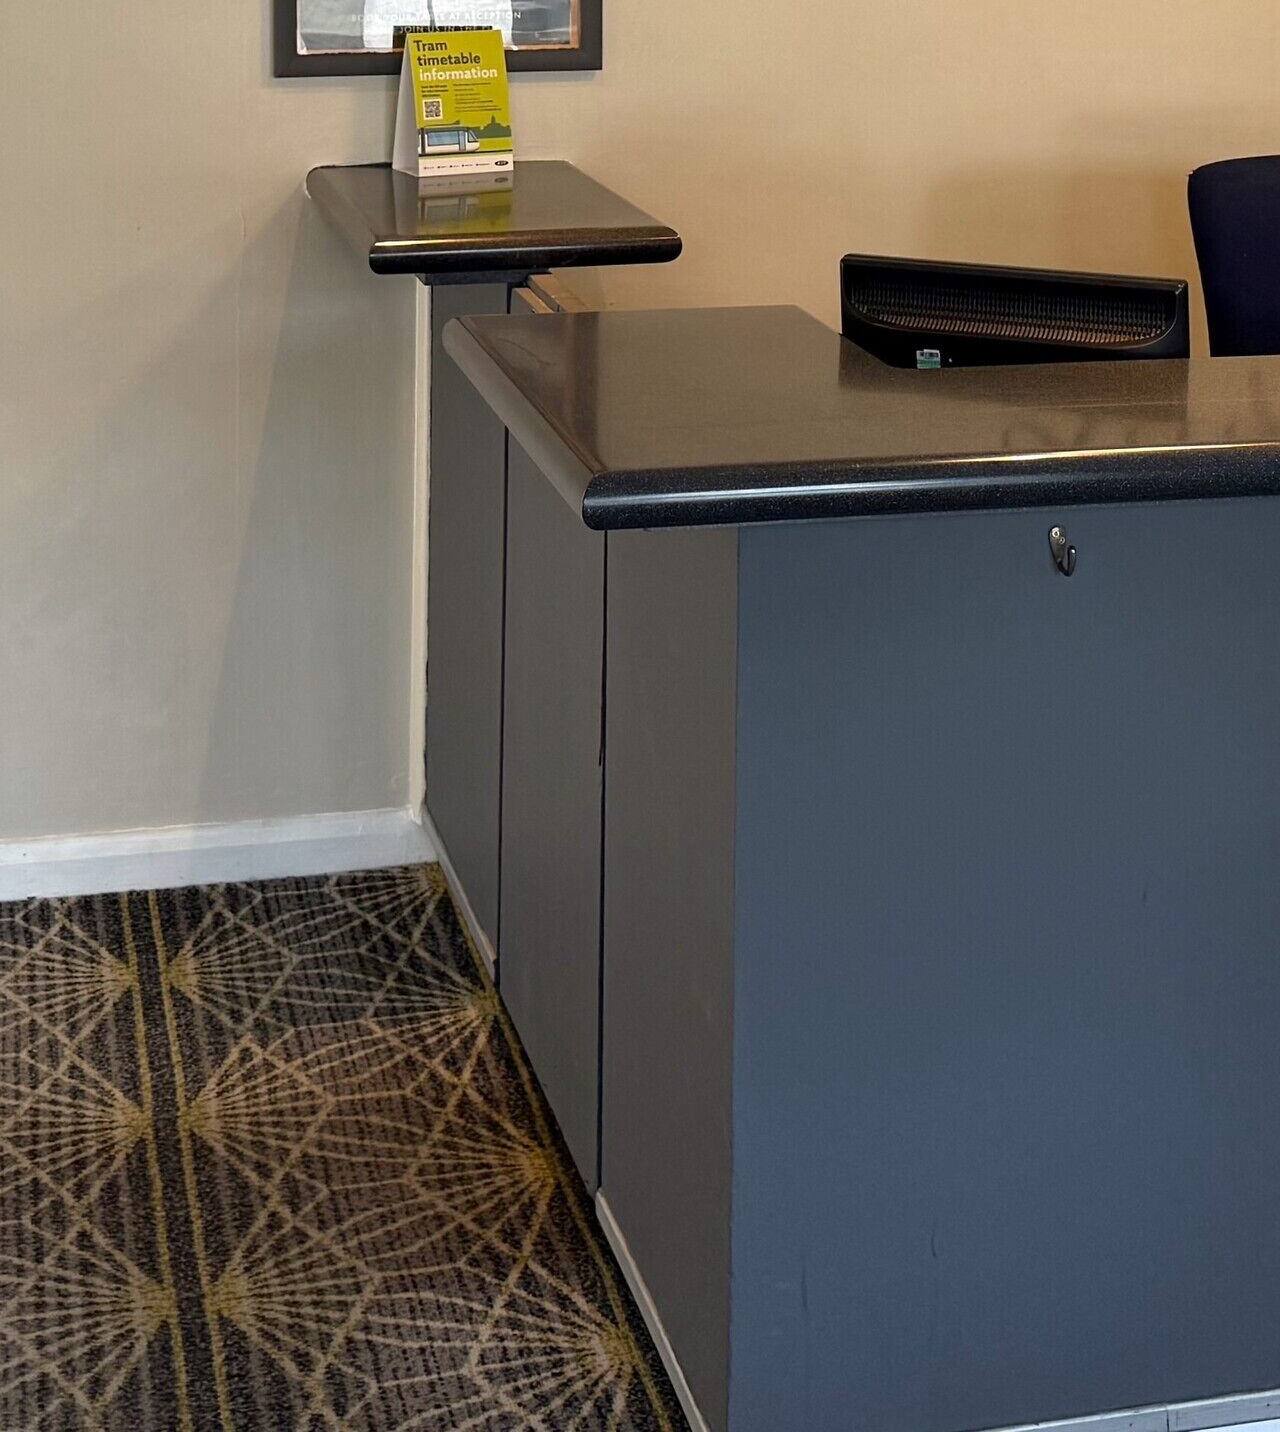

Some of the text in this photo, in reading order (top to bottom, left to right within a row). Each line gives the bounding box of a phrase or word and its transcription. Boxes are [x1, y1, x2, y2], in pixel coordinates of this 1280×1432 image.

[413, 40, 448, 52] Tram
[417, 52, 481, 67] timetable
[419, 67, 498, 81] information
